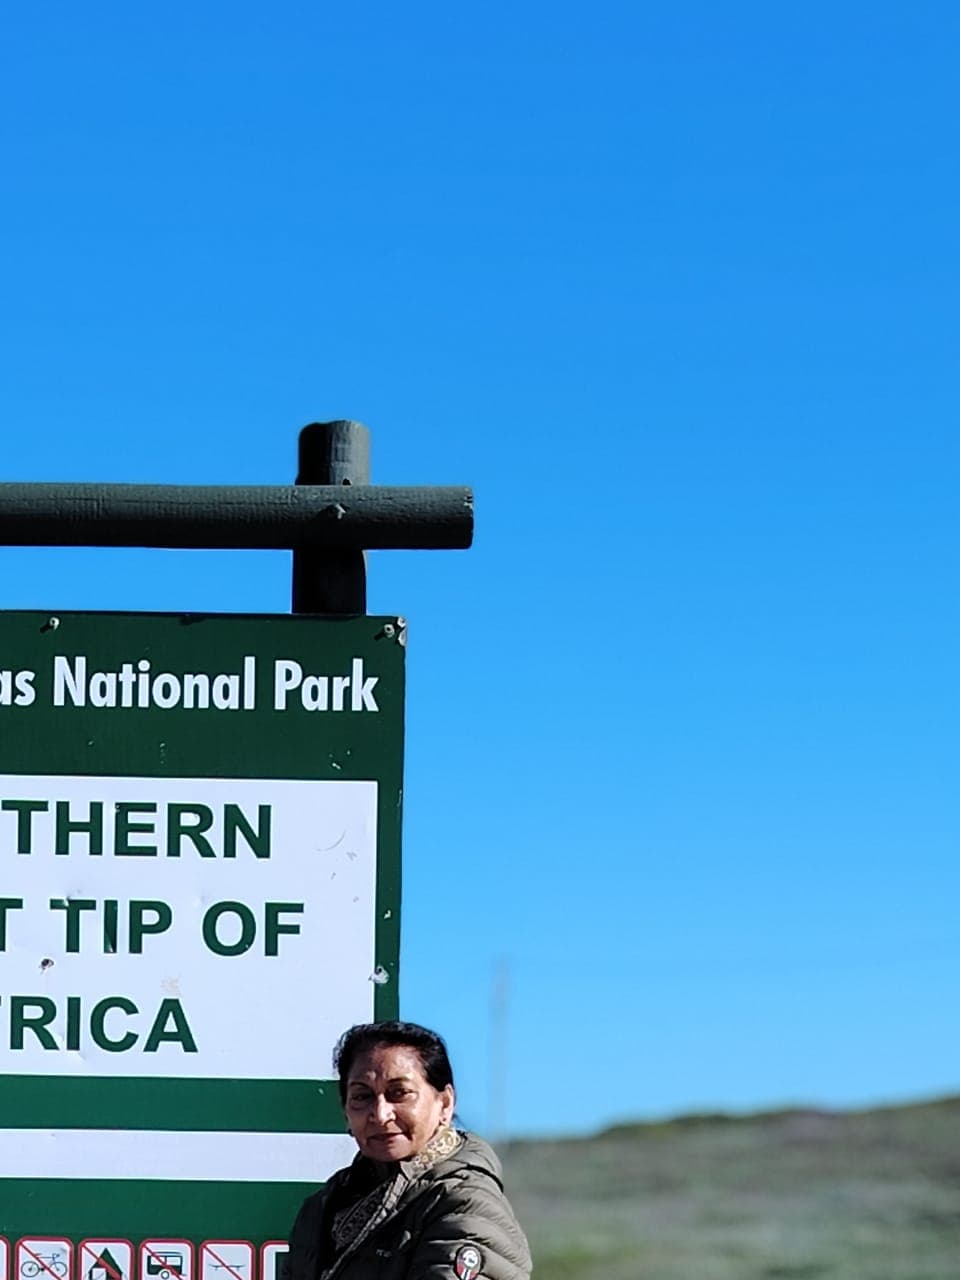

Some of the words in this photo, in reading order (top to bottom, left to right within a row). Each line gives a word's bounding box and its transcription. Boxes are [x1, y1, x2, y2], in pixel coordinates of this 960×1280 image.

[53, 656, 256, 710] National
[275, 658, 379, 711] Park
[49, 897, 173, 955] TIP
[202, 900, 305, 957] OF
